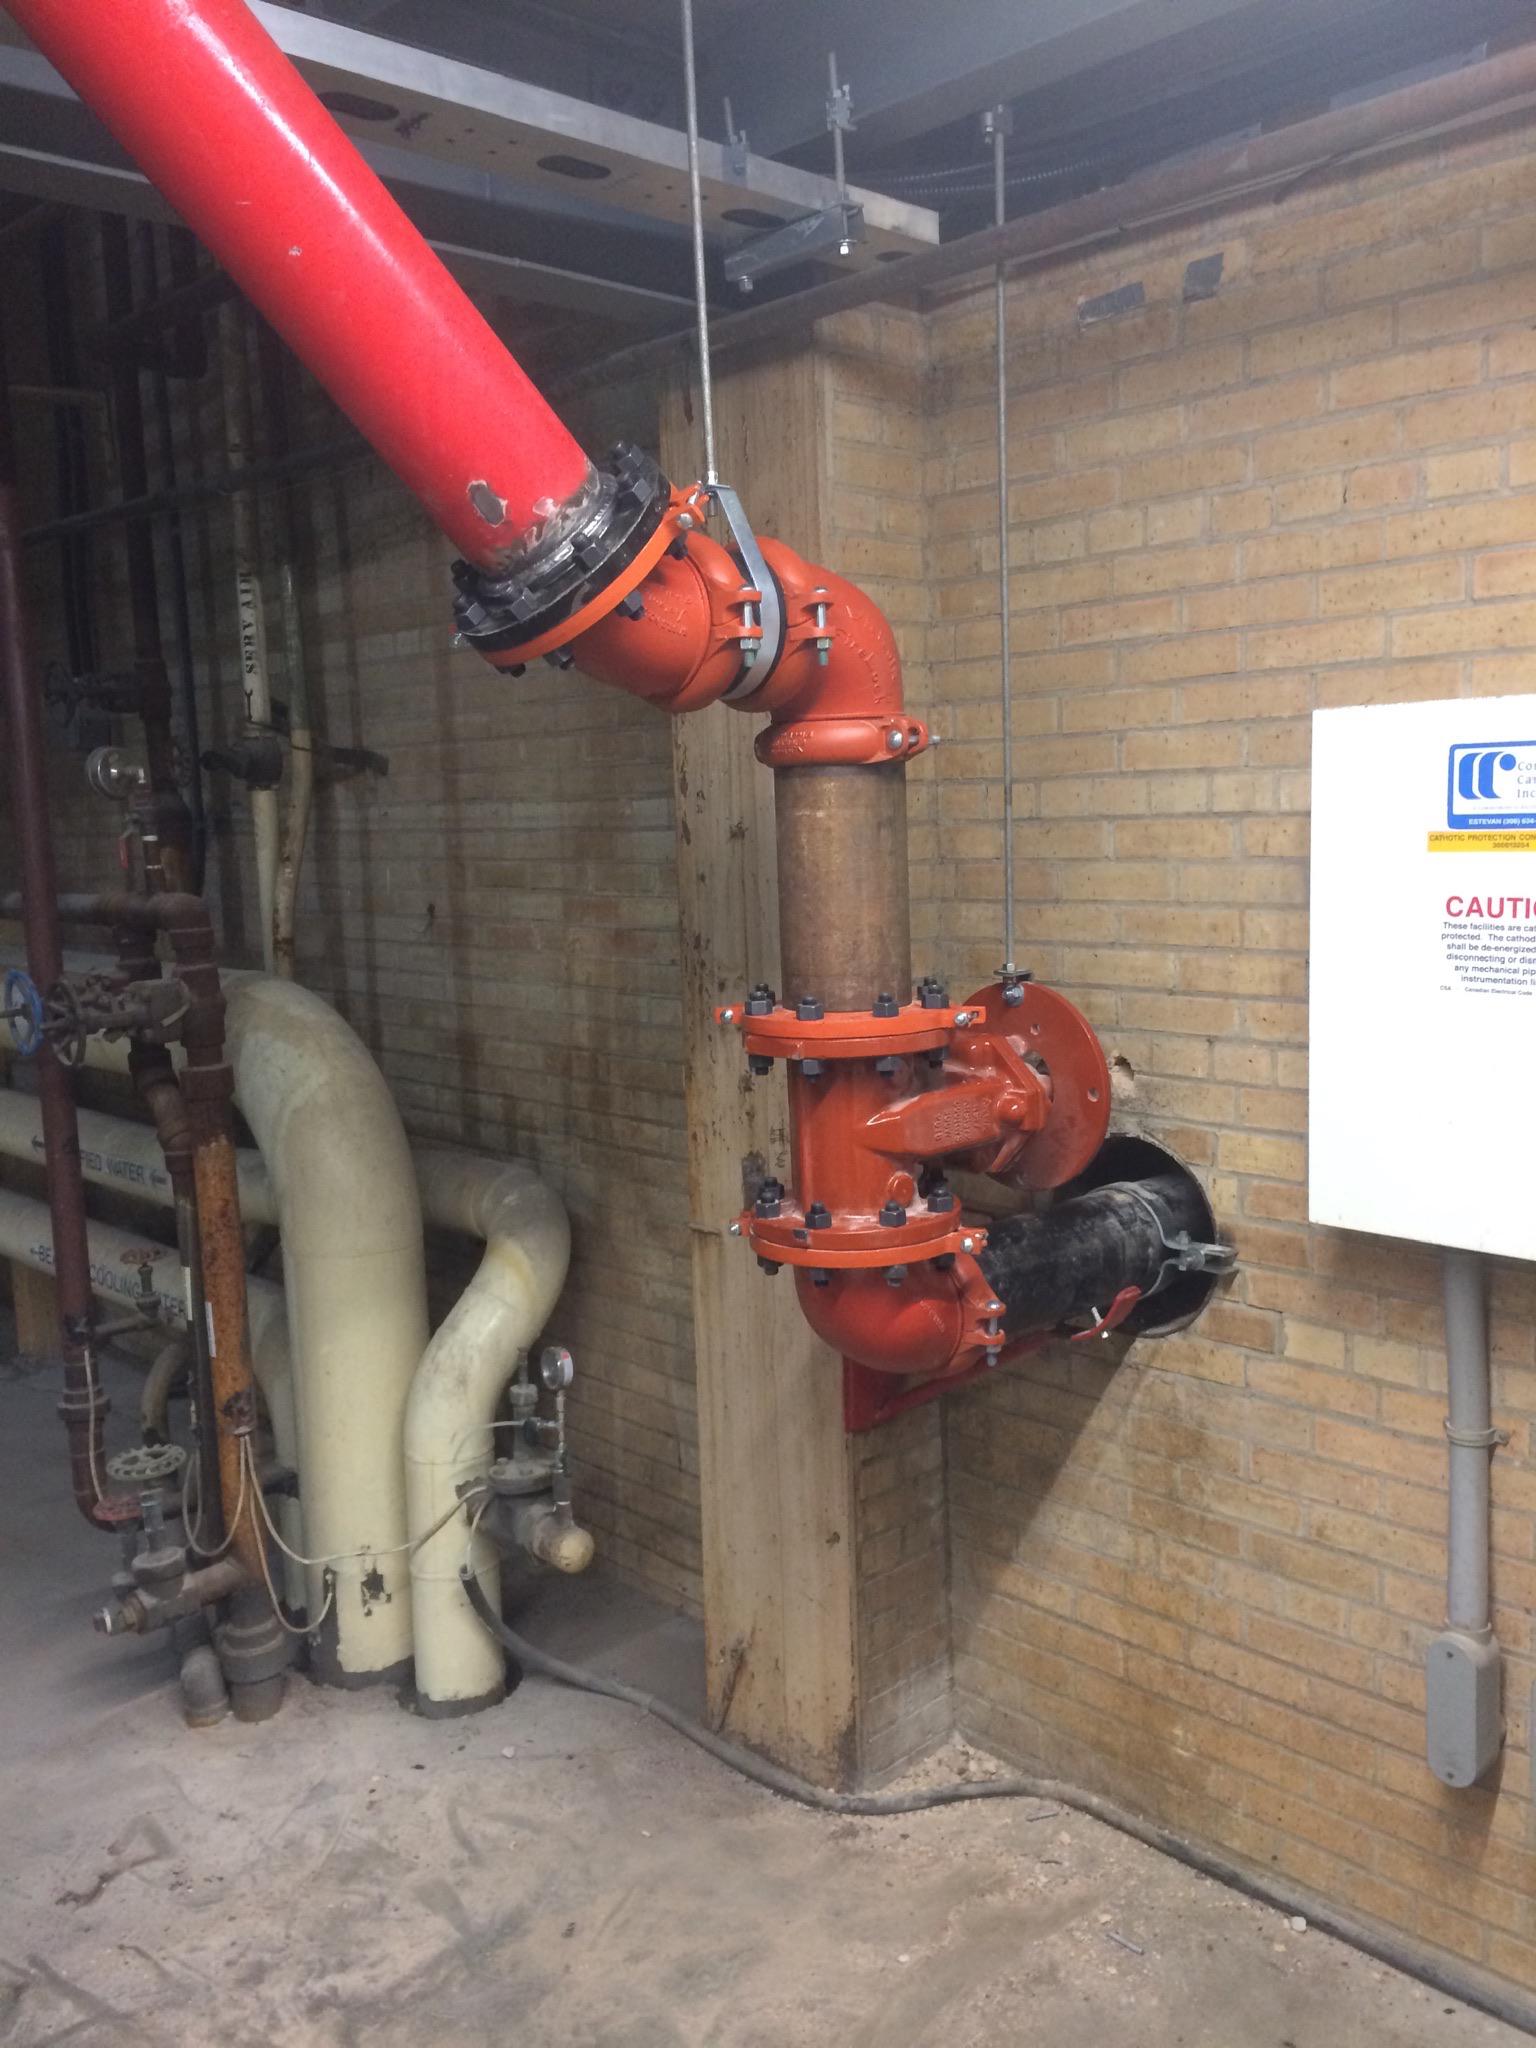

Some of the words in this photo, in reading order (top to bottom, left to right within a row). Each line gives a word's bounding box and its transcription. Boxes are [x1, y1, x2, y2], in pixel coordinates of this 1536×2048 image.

[1467, 833, 1516, 841] PROTECTION
[1445, 895, 1536, 919] CAUTI
[1443, 921, 1468, 930] These
[1469, 922, 1505, 931] facilities
[1507, 924, 1521, 932] are
[1488, 933, 1504, 942] The
[1446, 942, 1466, 950] shall
[1468, 943, 1479, 951] be
[1446, 952, 1505, 965] disconnecting
[1507, 956, 1517, 964] or
[1454, 965, 1469, 973] any
[1471, 965, 1519, 975] mechanical
[1461, 974, 1528, 986] instrumentation
[105, 1156, 146, 1184] WATER
